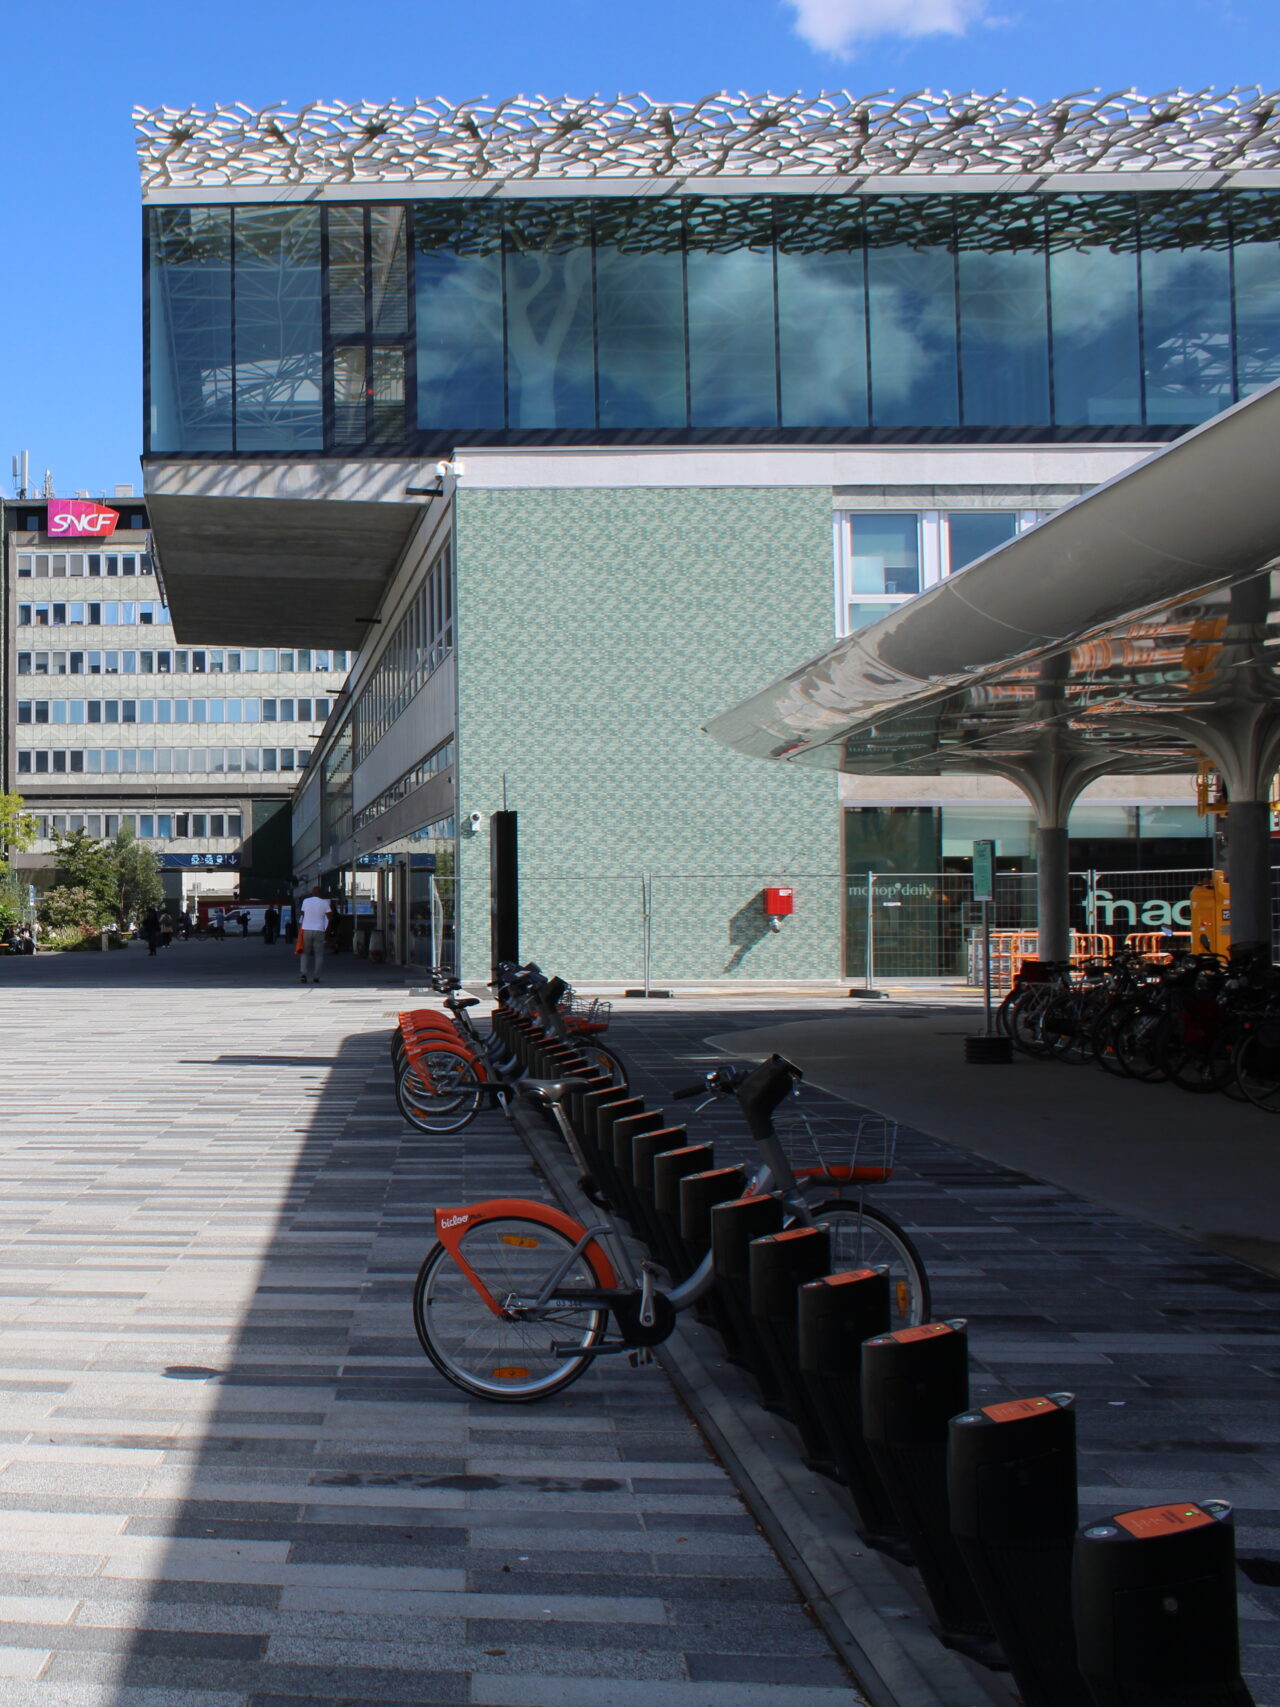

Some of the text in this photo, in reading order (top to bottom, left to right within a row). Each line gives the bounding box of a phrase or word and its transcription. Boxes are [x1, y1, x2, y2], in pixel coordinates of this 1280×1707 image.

[51, 514, 115, 532] SNCF
[1081, 890, 1192, 925] fnac
[441, 1214, 468, 1229] bicloo
